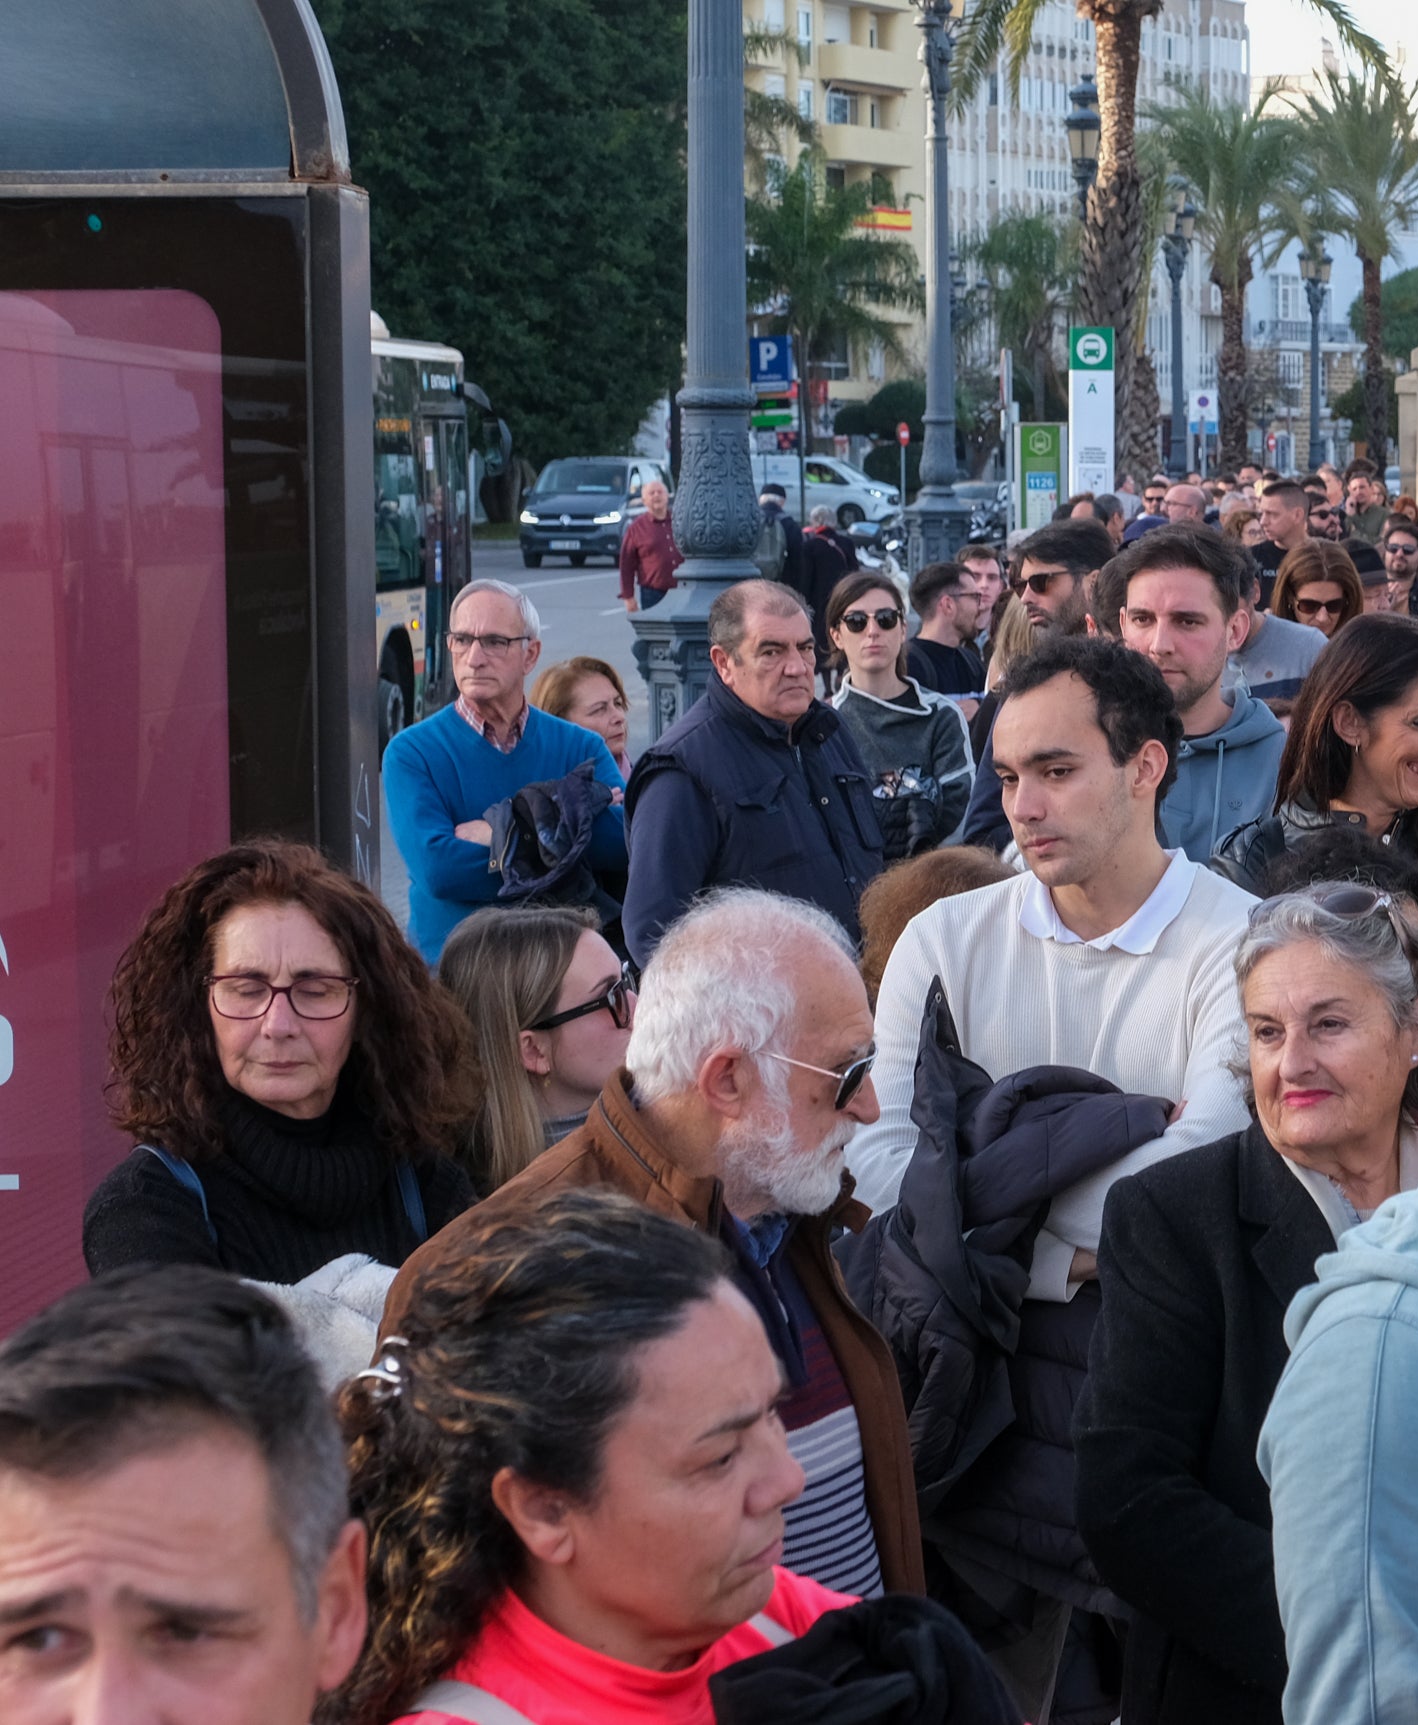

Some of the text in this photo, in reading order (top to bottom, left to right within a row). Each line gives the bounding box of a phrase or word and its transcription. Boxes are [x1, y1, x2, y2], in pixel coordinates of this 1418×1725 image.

[759, 341, 778, 371] P
[1087, 383, 1098, 394] A
[1029, 478, 1054, 488] 1126
